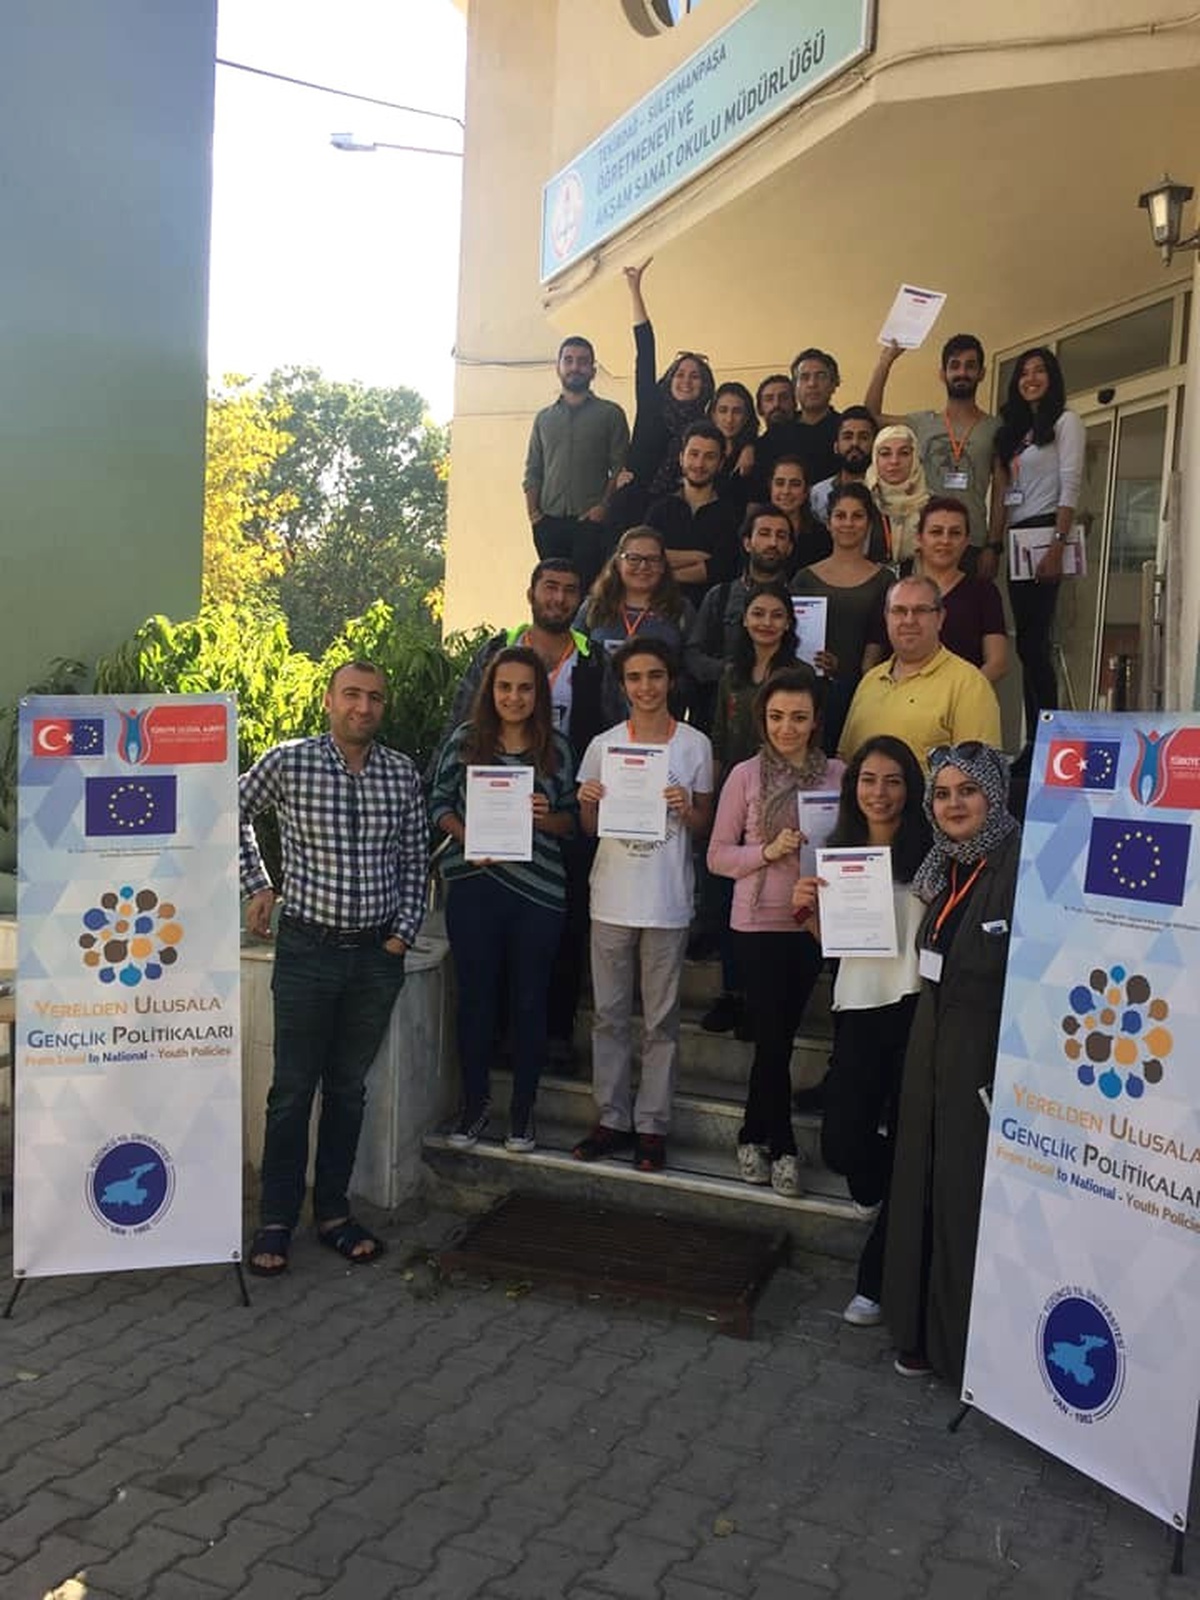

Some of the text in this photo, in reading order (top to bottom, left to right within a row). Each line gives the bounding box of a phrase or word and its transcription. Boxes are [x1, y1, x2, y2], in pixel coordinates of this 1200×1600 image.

[635, 151, 674, 199] SANAT
[676, 113, 721, 167] OKULU
[724, 28, 825, 134] MÜDÜRLÜĞÜ
[597, 98, 693, 195] ÖĞRETMENEVİ VE
[33, 995, 222, 1018] YERELDEN ULUSALA
[27, 1025, 233, 1050] GENÇLİK POLİTİKALARI
[102, 1050, 148, 1064] National
[158, 1047, 188, 1058] Youth
[191, 1044, 231, 1056] Policies
[1013, 1082, 1104, 1132] YERELDEN
[1001, 1117, 1079, 1164] GENÇLİK
[1057, 1168, 1068, 1182] to
[1070, 1173, 1116, 1200] National
[1126, 1191, 1160, 1217] Youth
[1053, 1395, 1069, 1414] VAN
